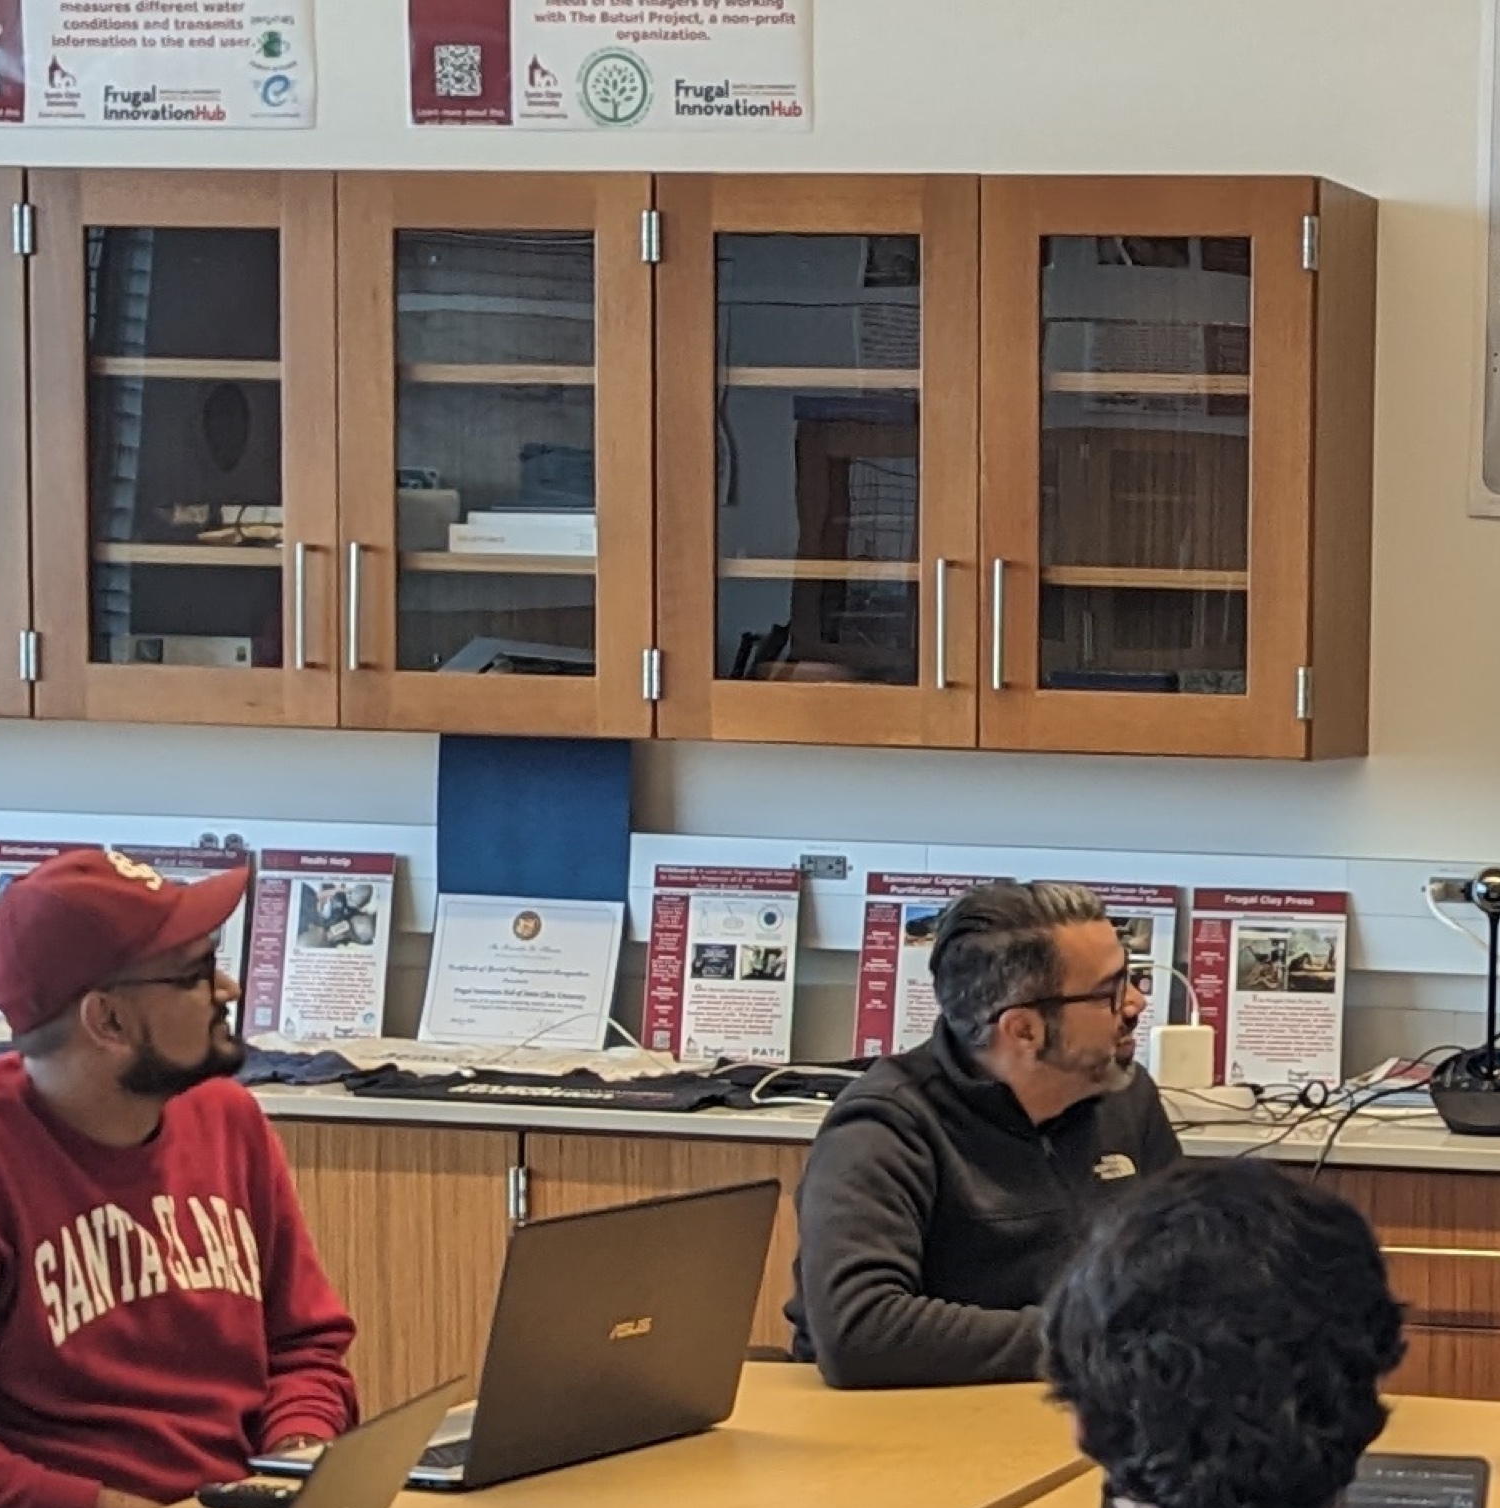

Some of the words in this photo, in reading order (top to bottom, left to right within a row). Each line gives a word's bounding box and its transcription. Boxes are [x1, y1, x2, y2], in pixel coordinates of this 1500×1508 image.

[136, 0, 198, 13] different
[204, 1, 244, 13] water
[62, 18, 139, 31] conditions
[144, 18, 170, 31] and
[174, 18, 244, 31] transmits
[534, 11, 566, 23] with
[571, 11, 596, 23] The
[648, 11, 703, 26] Project,
[708, 14, 718, 24] a
[722, 11, 796, 25] non-profit
[52, 35, 137, 48] information
[141, 36, 156, 48] to
[161, 35, 184, 48] the
[188, 36, 215, 49] end
[615, 28, 711, 42] organization.
[103, 85, 157, 105] Frugal
[674, 79, 729, 100] Frugal
[103, 104, 227, 122] InnovationHub
[674, 100, 803, 118] InnovationHub
[1223, 894, 1258, 906] Frugal
[1259, 895, 1284, 907] Clay
[1285, 895, 1316, 907] Press
[751, 1046, 786, 1058] PATH
[34, 1203, 167, 1348] SANTA
[159, 1195, 264, 1302] CLARA
[609, 1317, 652, 1340] ASUS
